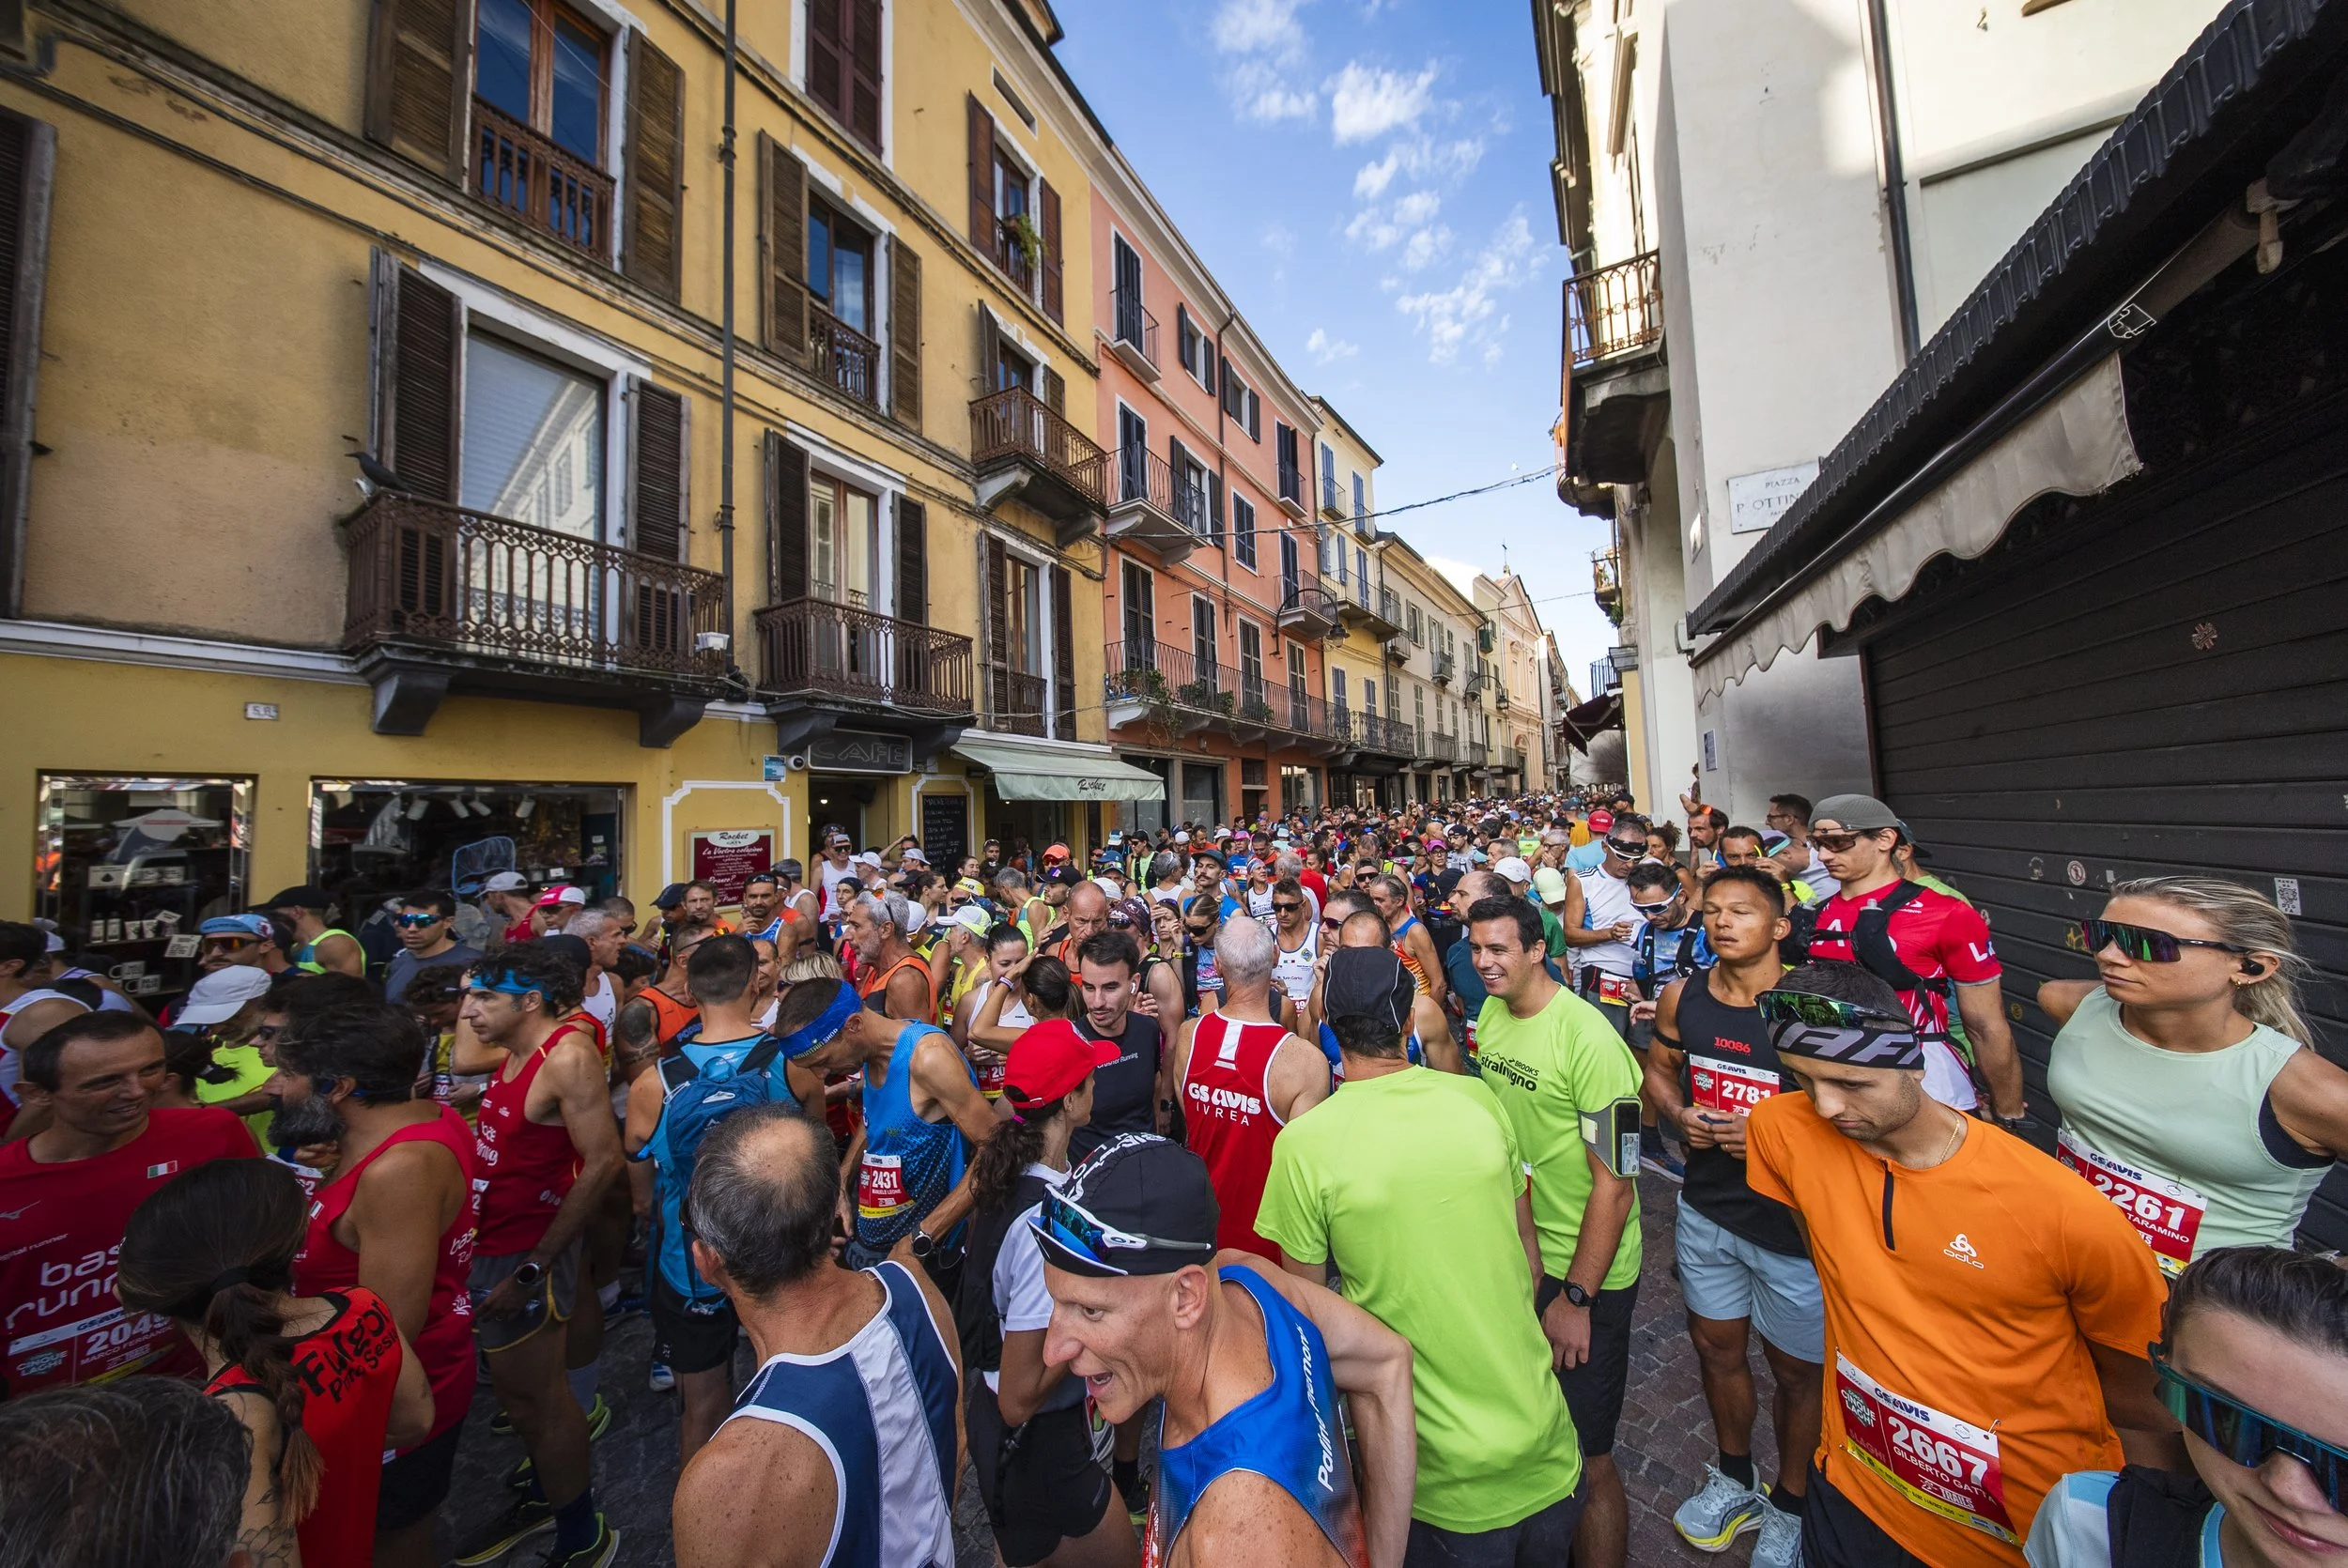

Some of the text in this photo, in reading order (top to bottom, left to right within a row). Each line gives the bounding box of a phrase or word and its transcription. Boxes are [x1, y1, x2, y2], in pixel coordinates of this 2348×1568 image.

[1765, 477, 1800, 488] PIAZZA
[1753, 493, 1802, 510] OTTIN
[823, 1028, 839, 1043] SHOP
[1714, 1037, 1751, 1053] 10086
[1120, 1052, 1138, 1064] Running
[1514, 1060, 1539, 1077] BROOKS
[1722, 1080, 1771, 1104] 2781
[872, 1170, 898, 1189] 2431
[2094, 1174, 2186, 1231] 2261
[2126, 1212, 2190, 1243] TARAMINO
[1943, 1248, 1985, 1269] odlo
[16, 1350, 68, 1371] CINQUE
[80, 1345, 121, 1366] MARCO
[21, 1359, 62, 1376] LAGHI
[1841, 1389, 1876, 1421] CINQUE
[1846, 1400, 1875, 1428] LAGHI
[1888, 1416, 1988, 1487] 2667
[1892, 1446, 1950, 1483] GILBERTO
[1940, 1485, 1975, 1510] TRAILS
